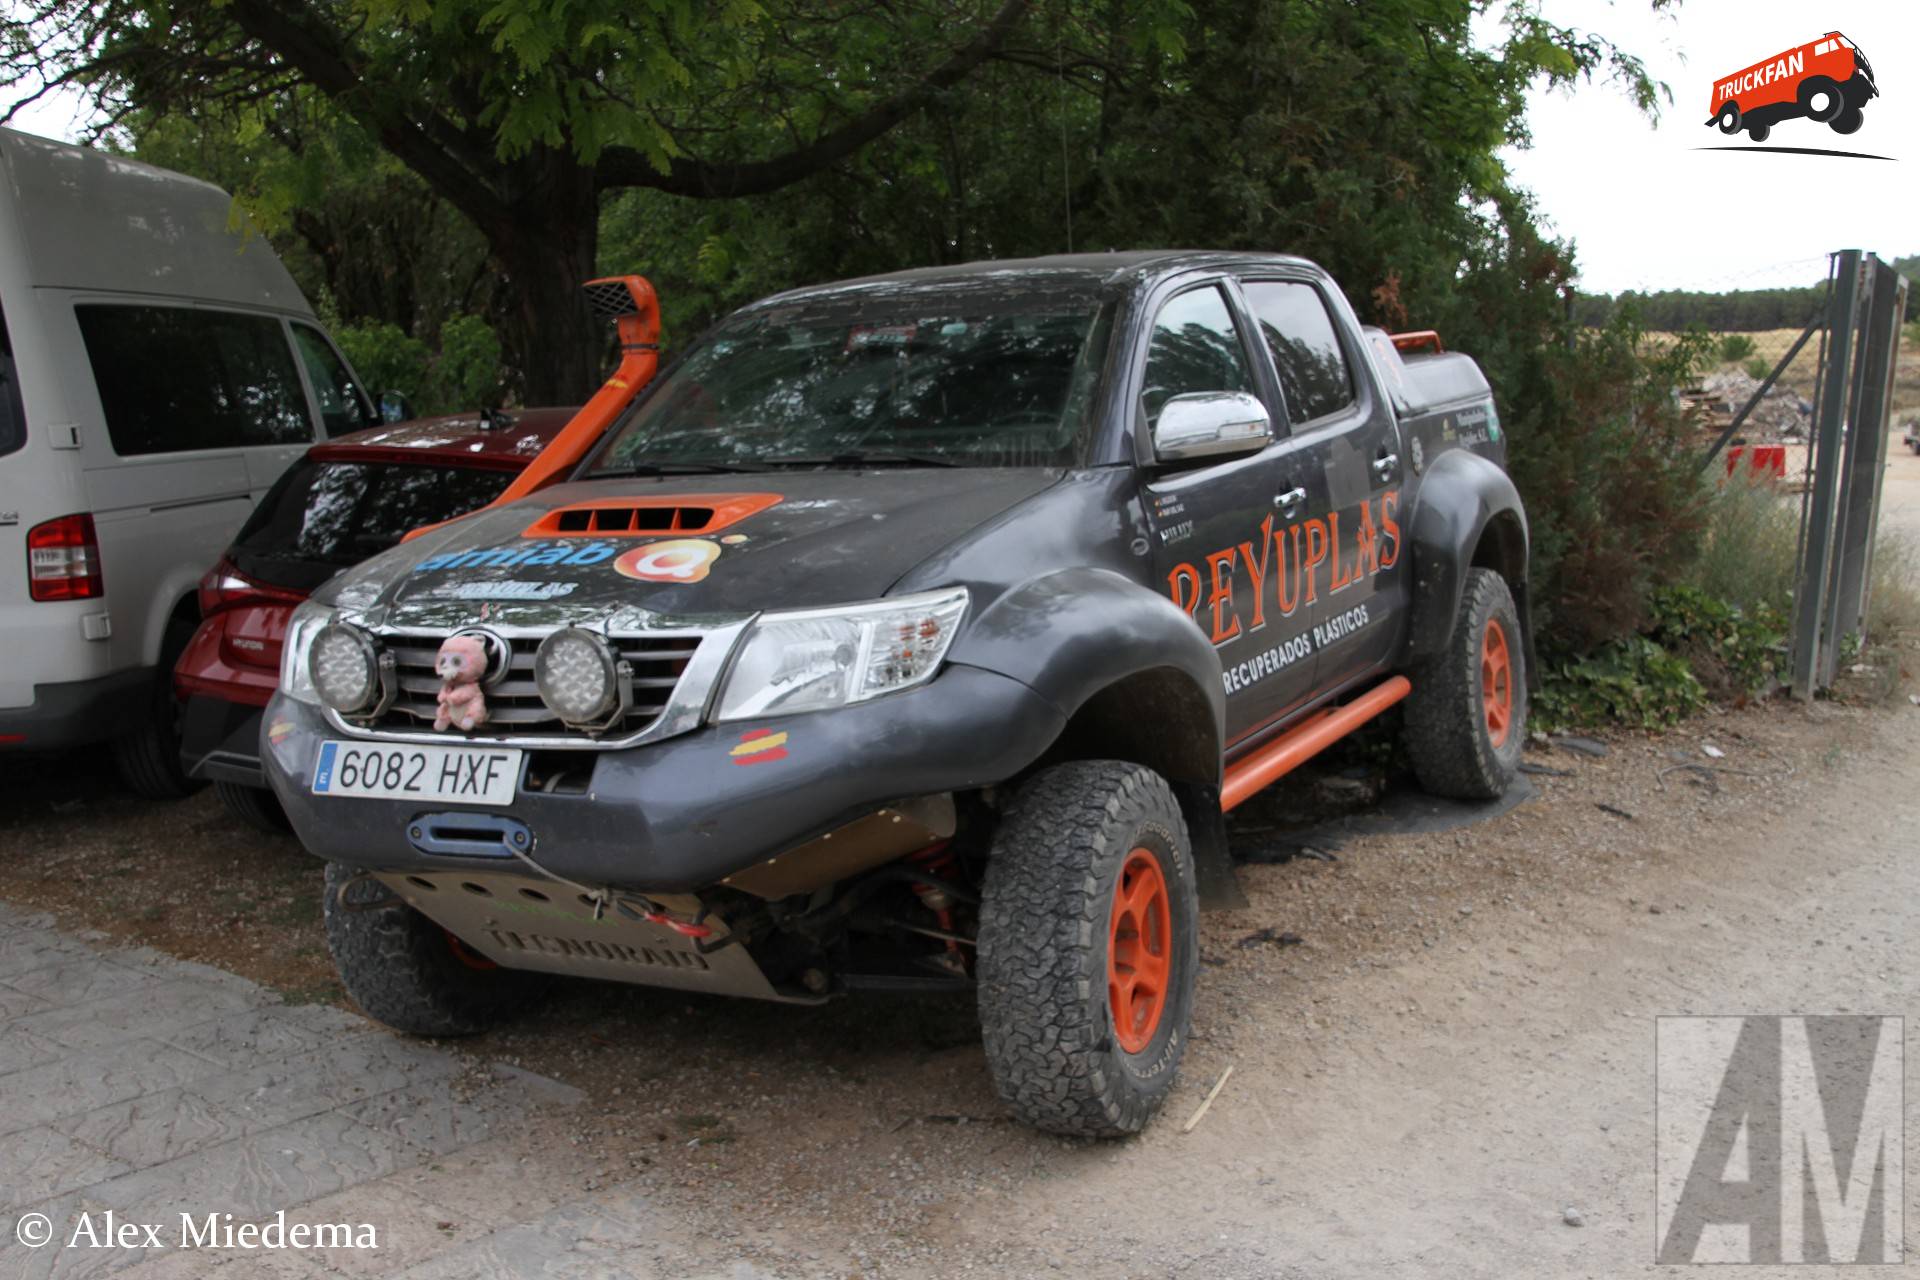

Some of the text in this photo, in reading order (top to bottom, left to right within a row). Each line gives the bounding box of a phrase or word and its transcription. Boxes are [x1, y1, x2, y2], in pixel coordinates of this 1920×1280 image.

[414, 542, 616, 572] amiab
[1168, 491, 1400, 649] REYUPLAS
[1222, 633, 1311, 695] RECUPERADOS
[340, 750, 508, 795] 6082 HXF
